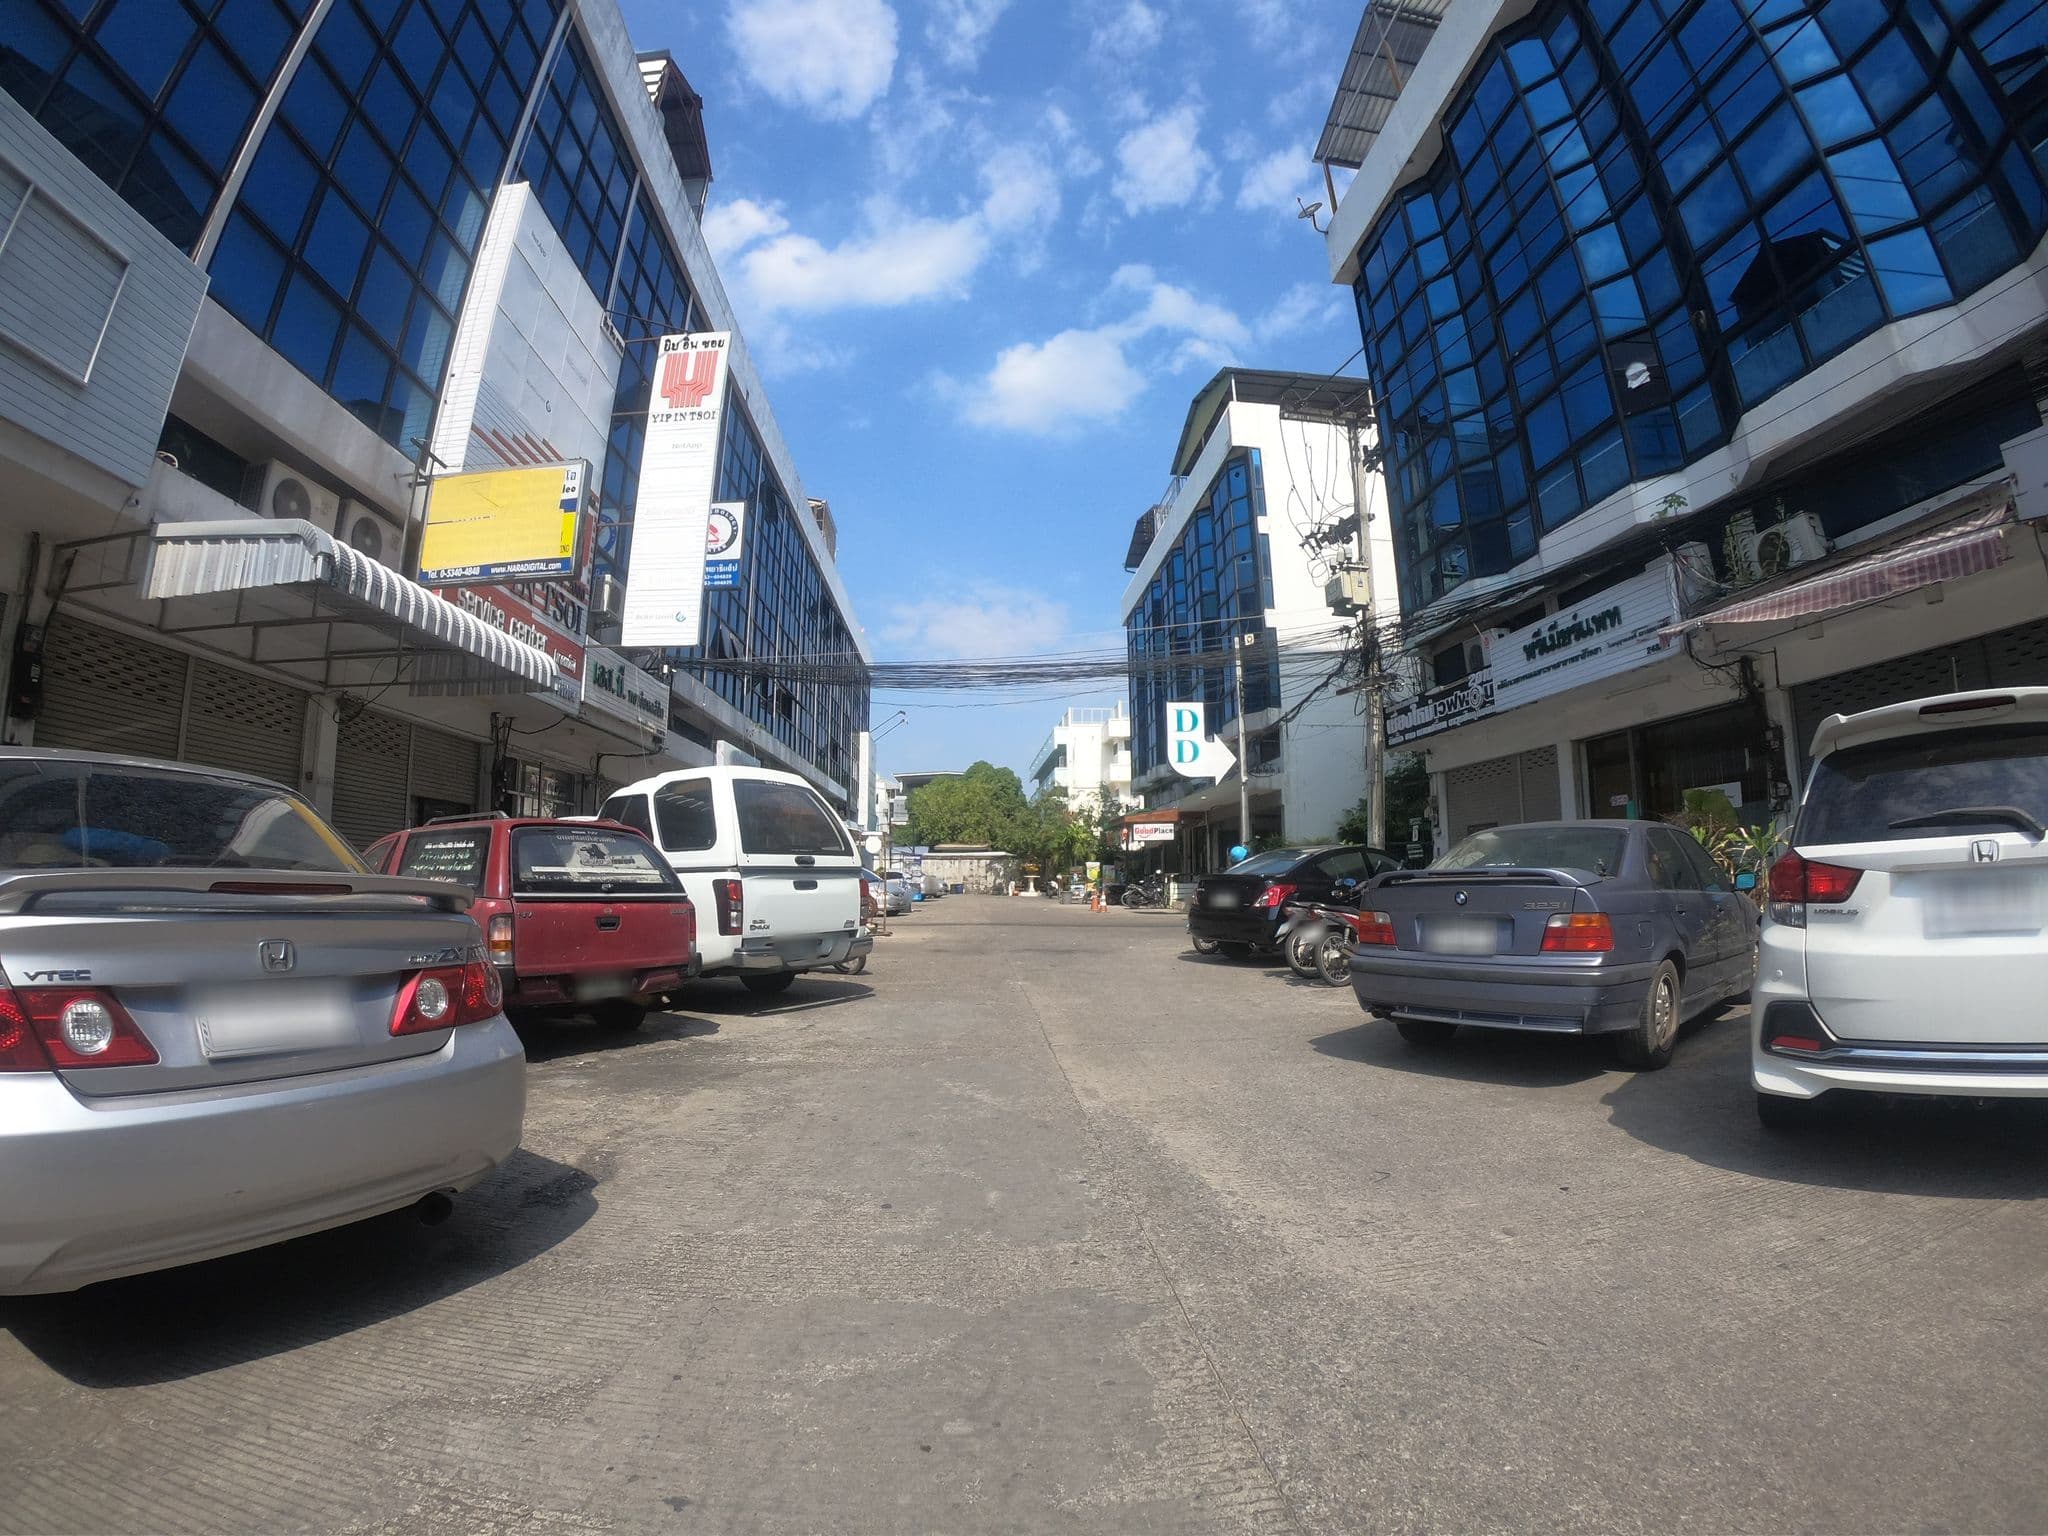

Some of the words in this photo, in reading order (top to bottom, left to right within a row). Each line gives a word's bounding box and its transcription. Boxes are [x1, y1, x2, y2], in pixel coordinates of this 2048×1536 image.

[652, 413, 672, 423] YIP
[674, 412, 687, 421] IN
[689, 410, 716, 421] TSOI
[1175, 708, 1199, 733] D
[1175, 739, 1200, 764] D
[23, 969, 91, 982] VTEC
